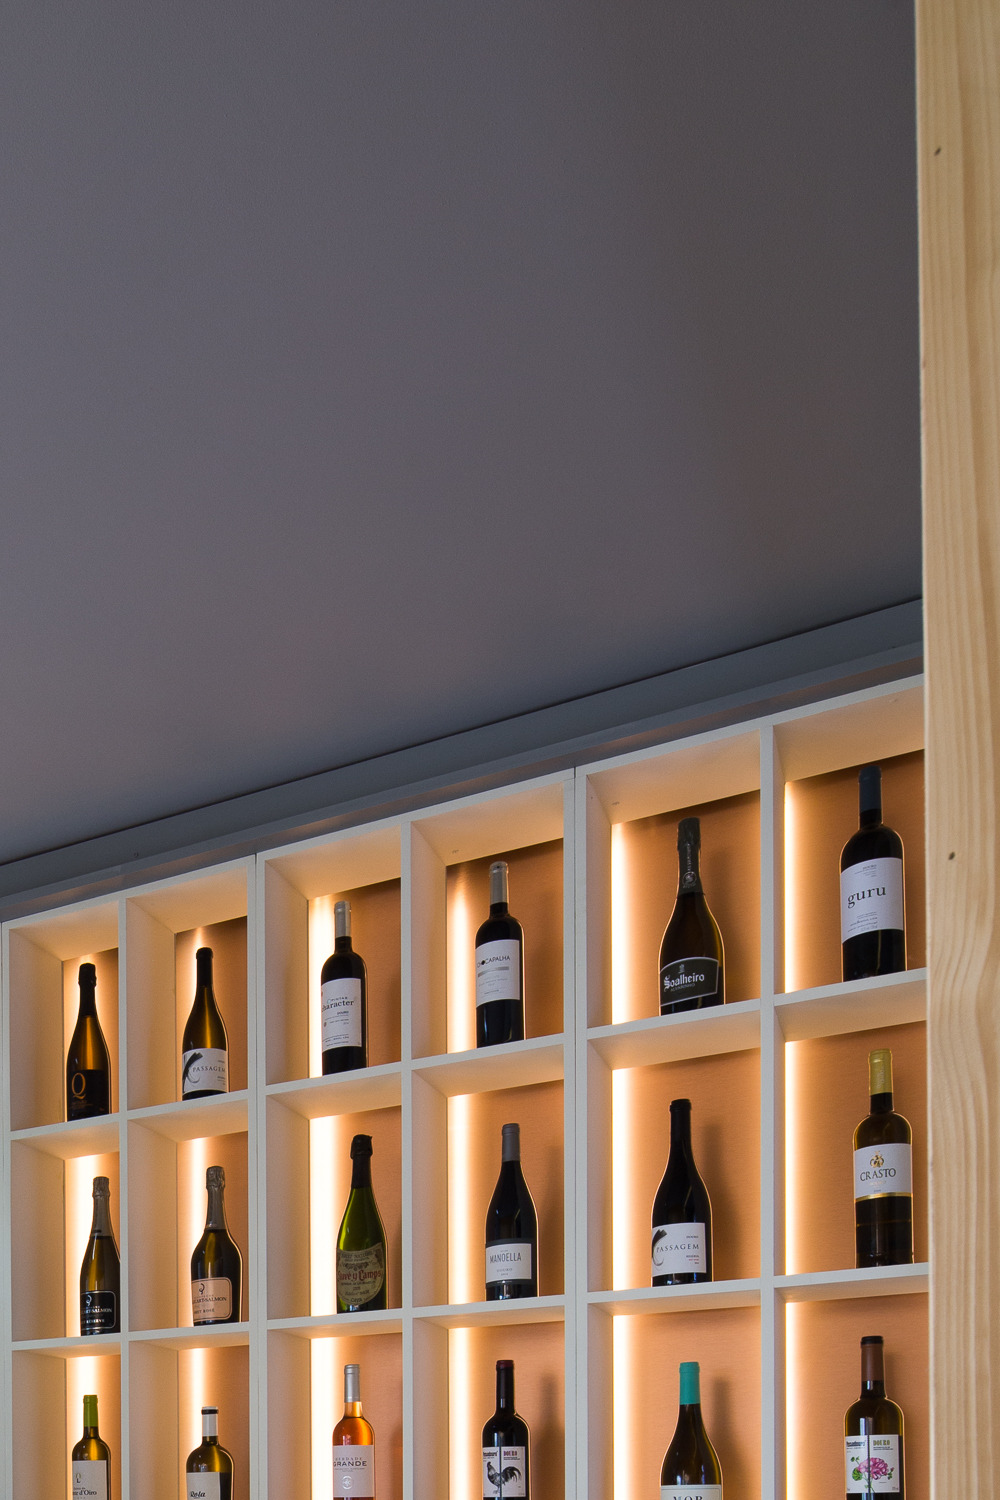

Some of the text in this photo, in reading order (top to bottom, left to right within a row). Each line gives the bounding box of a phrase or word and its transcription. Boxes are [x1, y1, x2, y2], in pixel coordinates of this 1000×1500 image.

[847, 887, 886, 909] guru
[664, 973, 704, 992] Soalheiro
[192, 1065, 226, 1073] PASSAGEM
[72, 1072, 86, 1100] Q
[859, 1168, 897, 1182] CRASTO
[656, 1244, 700, 1253] PASSAGEM
[489, 1252, 522, 1264] MANOELLA
[358, 1268, 382, 1282] Camps
